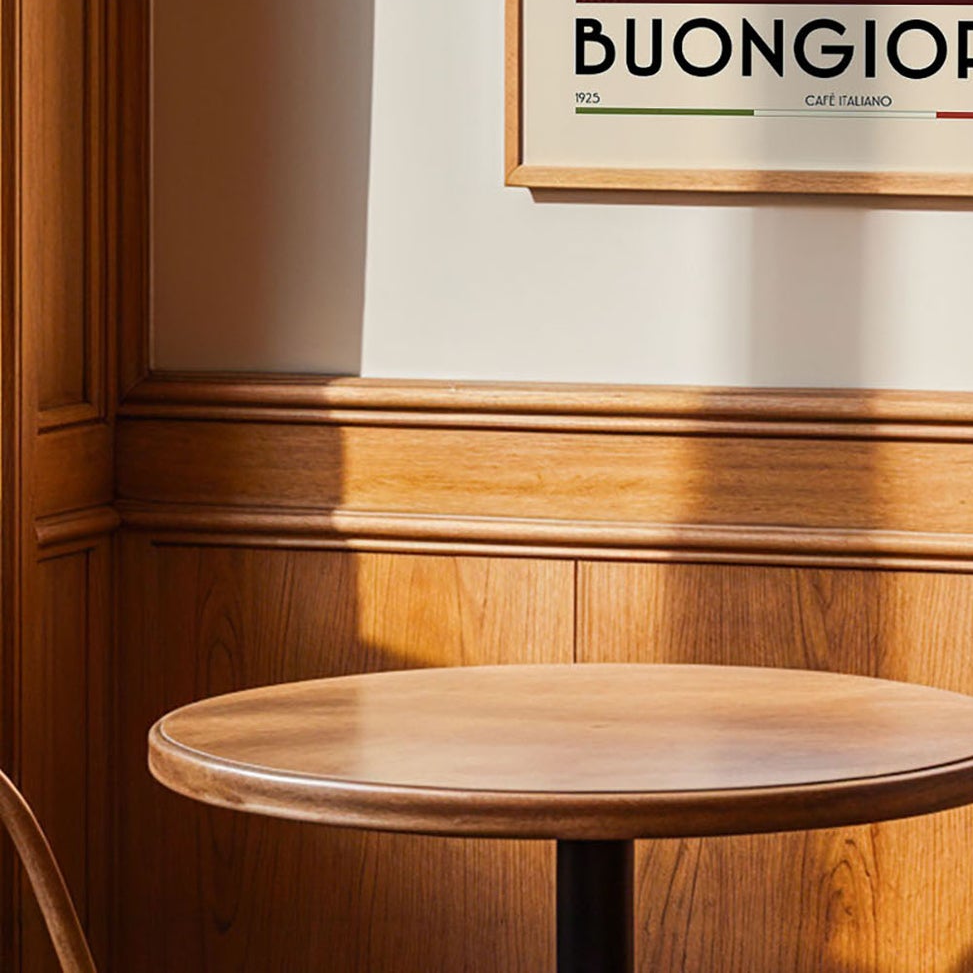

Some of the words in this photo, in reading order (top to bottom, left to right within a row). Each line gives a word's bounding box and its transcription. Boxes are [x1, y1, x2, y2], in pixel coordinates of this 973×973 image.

[575, 92, 601, 104] 1925
[805, 93, 835, 107] CAFÉ
[839, 95, 892, 107] ITALIANO
